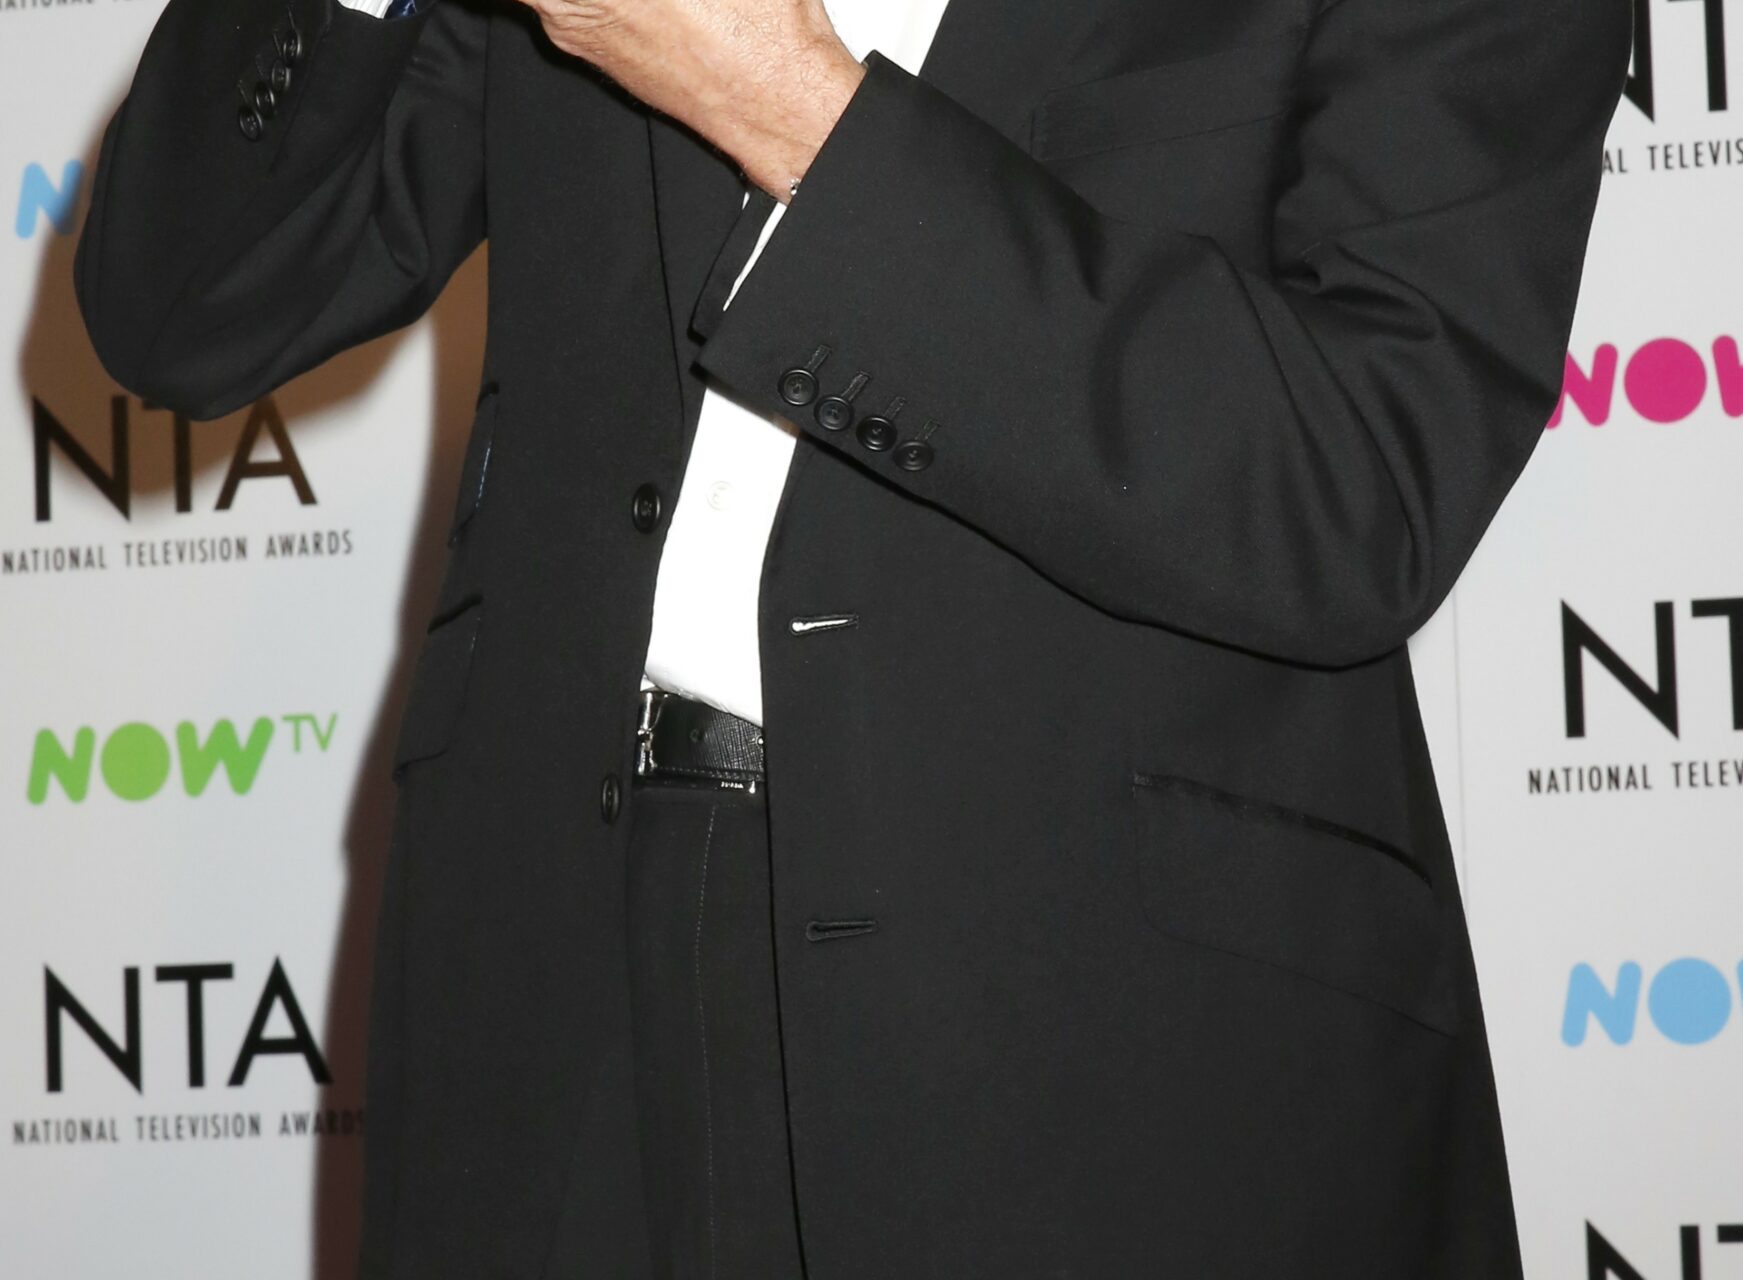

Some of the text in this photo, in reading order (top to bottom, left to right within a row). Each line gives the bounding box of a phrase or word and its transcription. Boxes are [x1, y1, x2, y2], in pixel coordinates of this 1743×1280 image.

[1647, 137, 1743, 171] TELEVIS
[1546, 334, 1743, 430] NO
[32, 394, 319, 523] NTA
[2, 528, 355, 573] NATIONAL TELEVISION AWARDS
[1560, 597, 1743, 740] NT
[26, 712, 339, 806] NOW TV
[1528, 758, 1743, 795] NATIONAL TELEV
[43, 955, 334, 1095] NTA
[1560, 956, 1743, 1048] NO
[13, 1117, 120, 1146] NATIONAL
[137, 1113, 262, 1142] TELEVISION
